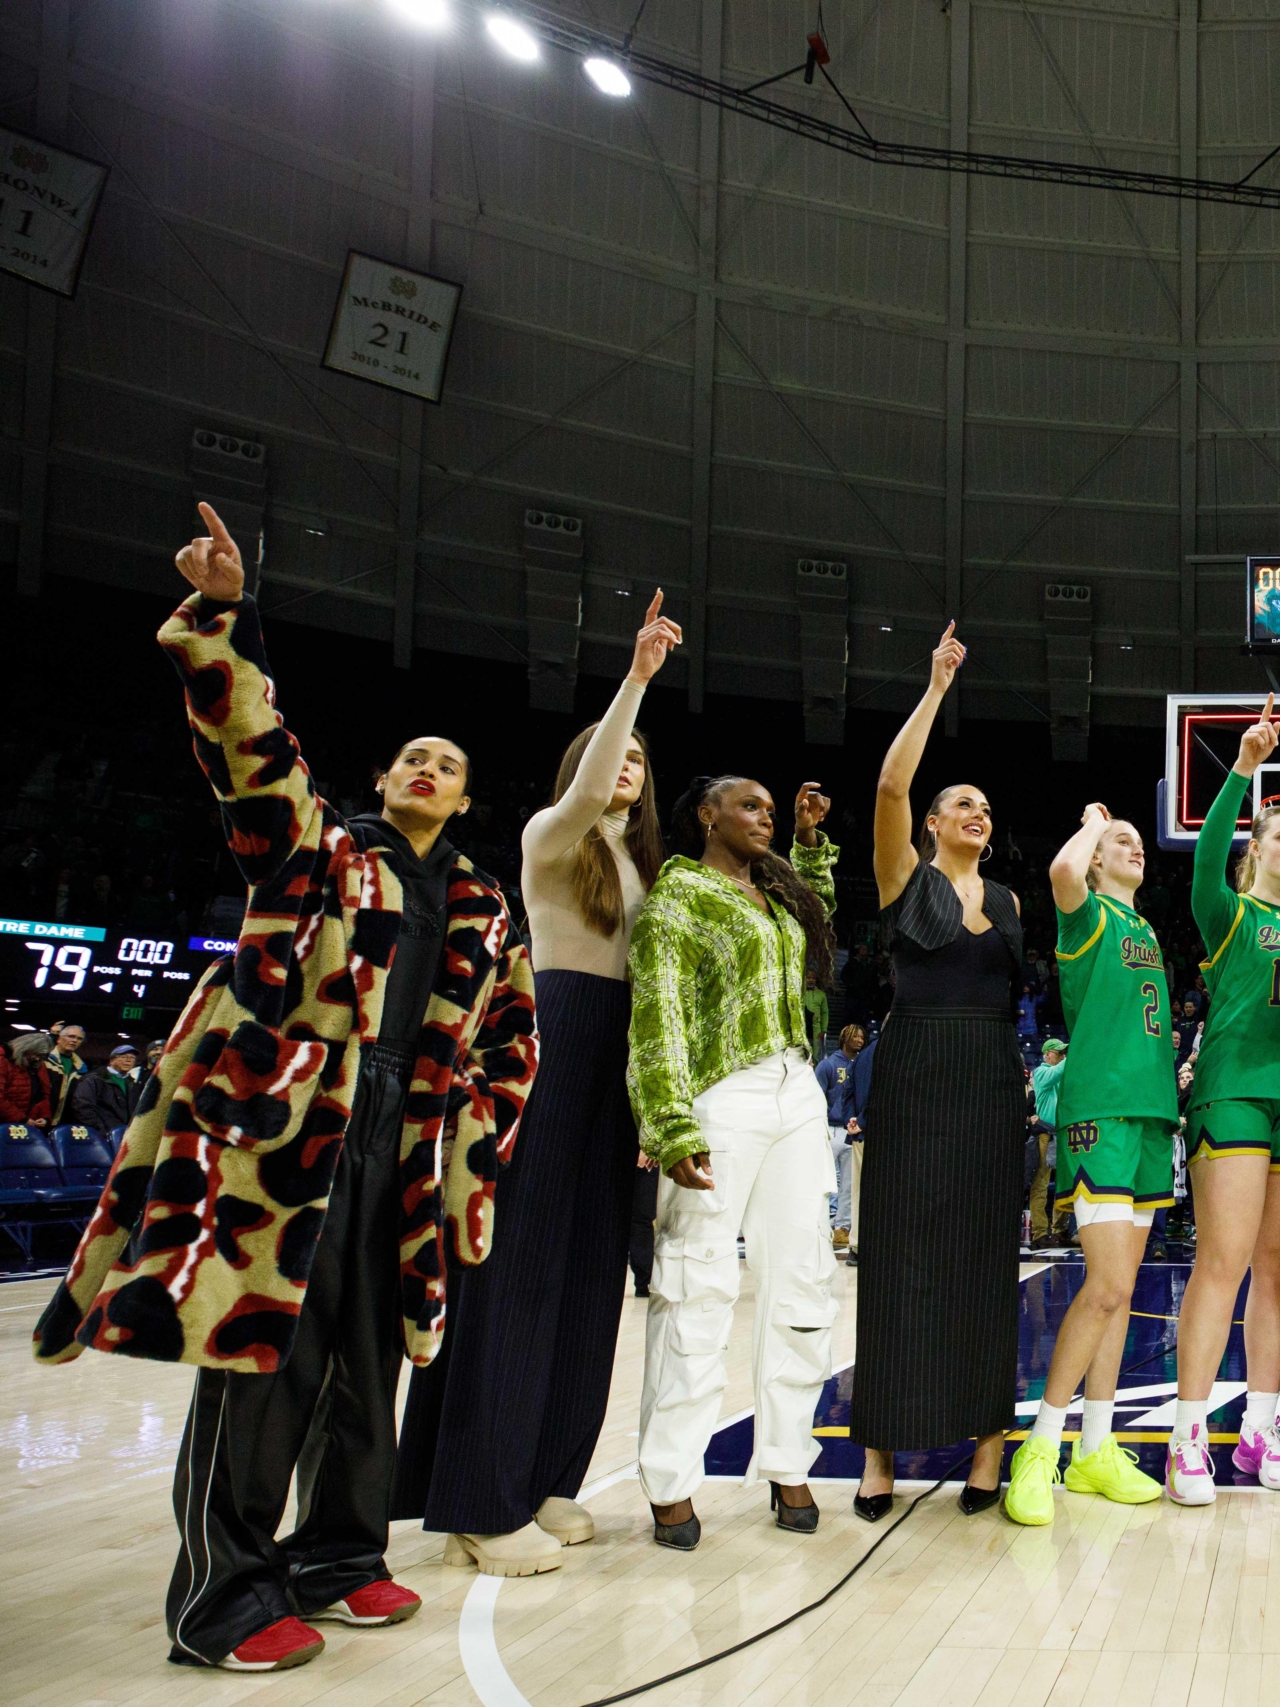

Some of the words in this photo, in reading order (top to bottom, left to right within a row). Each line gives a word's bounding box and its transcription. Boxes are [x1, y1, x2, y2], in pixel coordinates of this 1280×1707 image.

[12, 247, 49, 268] 2014
[352, 296, 442, 333] McBRIDE
[368, 323, 410, 356] 21
[351, 351, 380, 368] 2010
[392, 365, 421, 380] 2014
[34, 924, 86, 938] DAME
[24, 942, 92, 991] 79
[92, 965, 122, 975] POSS
[131, 968, 153, 977] PER
[163, 971, 191, 980] POSS
[133, 984, 146, 998] 4
[122, 1006, 143, 1020] EXIT
[1141, 981, 1161, 1037] 2
